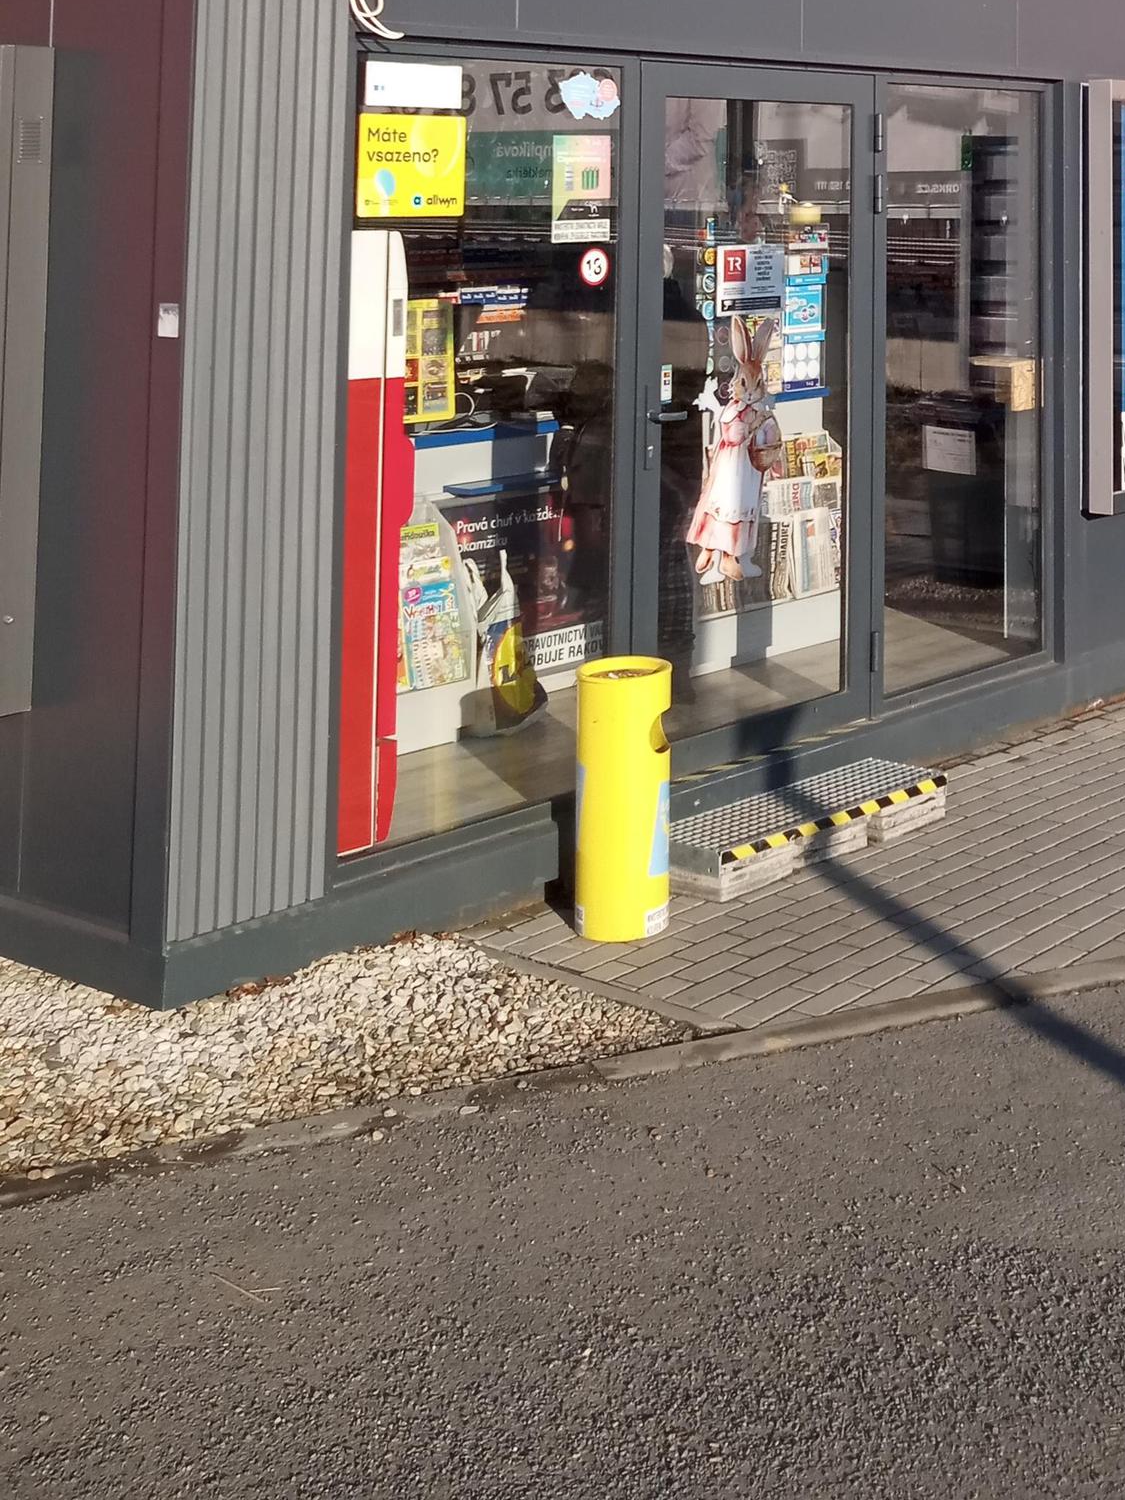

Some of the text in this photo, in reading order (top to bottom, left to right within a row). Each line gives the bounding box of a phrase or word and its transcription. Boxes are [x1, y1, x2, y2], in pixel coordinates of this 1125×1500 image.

[367, 127, 407, 142] Máte
[366, 148, 439, 163] vsazeno?
[426, 195, 457, 208] allwyn
[727, 257, 742, 271] TR
[457, 517, 488, 534] Pravá
